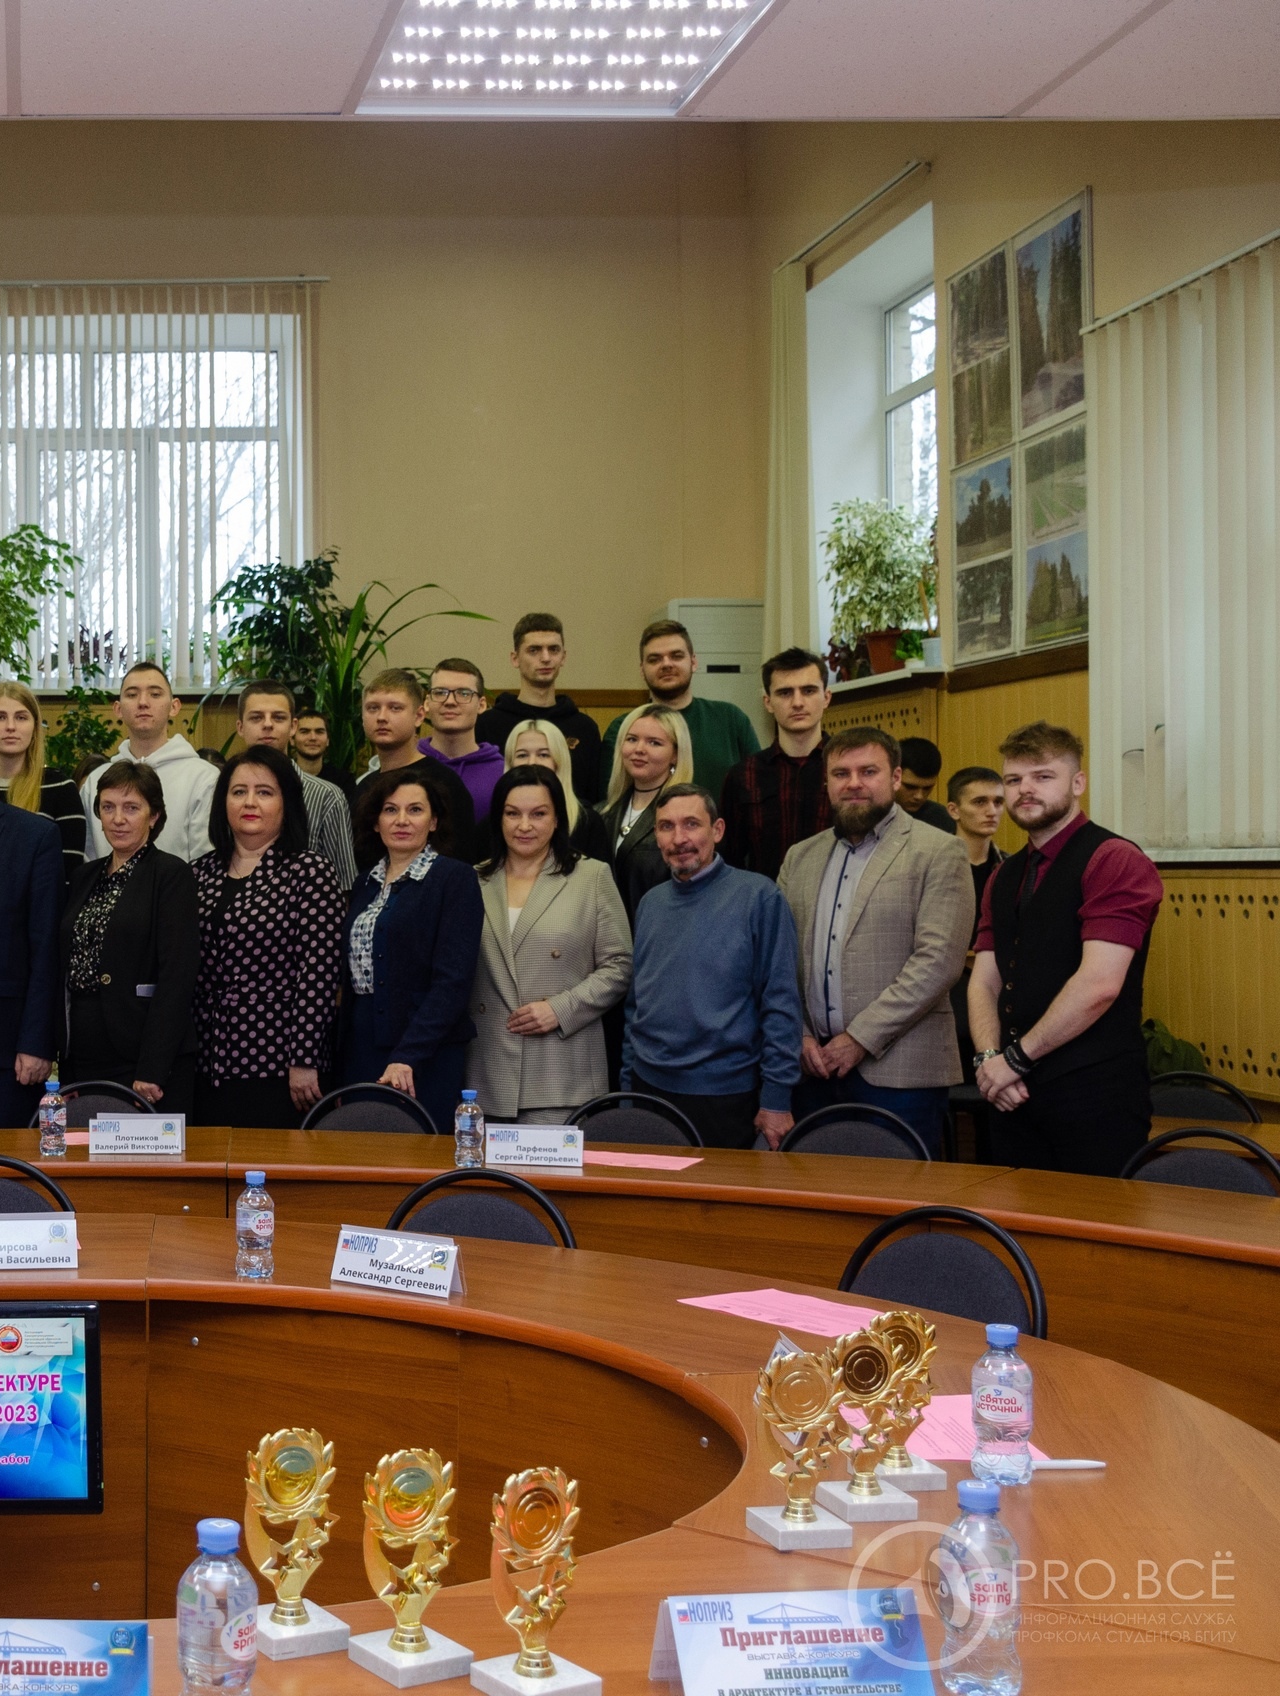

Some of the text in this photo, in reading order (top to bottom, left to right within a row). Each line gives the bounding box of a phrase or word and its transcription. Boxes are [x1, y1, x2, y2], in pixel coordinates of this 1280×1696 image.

[97, 1121, 120, 1133] НОПРИЗ
[495, 1130, 519, 1143] НОПРИЗ
[95, 1143, 129, 1151] Валерий
[516, 1145, 558, 1154] Парфенов
[495, 1153, 579, 1164] Сергей Григорьевич
[349, 1234, 378, 1254] НОПРИЗ
[6, 1254, 71, 1265] Васильевна
[369, 1258, 425, 1276] Музальков
[339, 1267, 448, 1293] Александр Сергеевич
[974, 1581, 1008, 1593] saint
[970, 1590, 1012, 1605] spring
[688, 1600, 734, 1623] НОПРИЗ
[720, 1626, 885, 1651] Приглашение
[747, 1650, 861, 1661] ВЫСТАВКА-КОНКУРС
[763, 1665, 850, 1680] ИННОВАЦИИ
[728, 1686, 802, 1696] АРХИТЕКТУРЕ
[815, 1683, 902, 1695] СТРОИТЕЛЬСТВЕ
